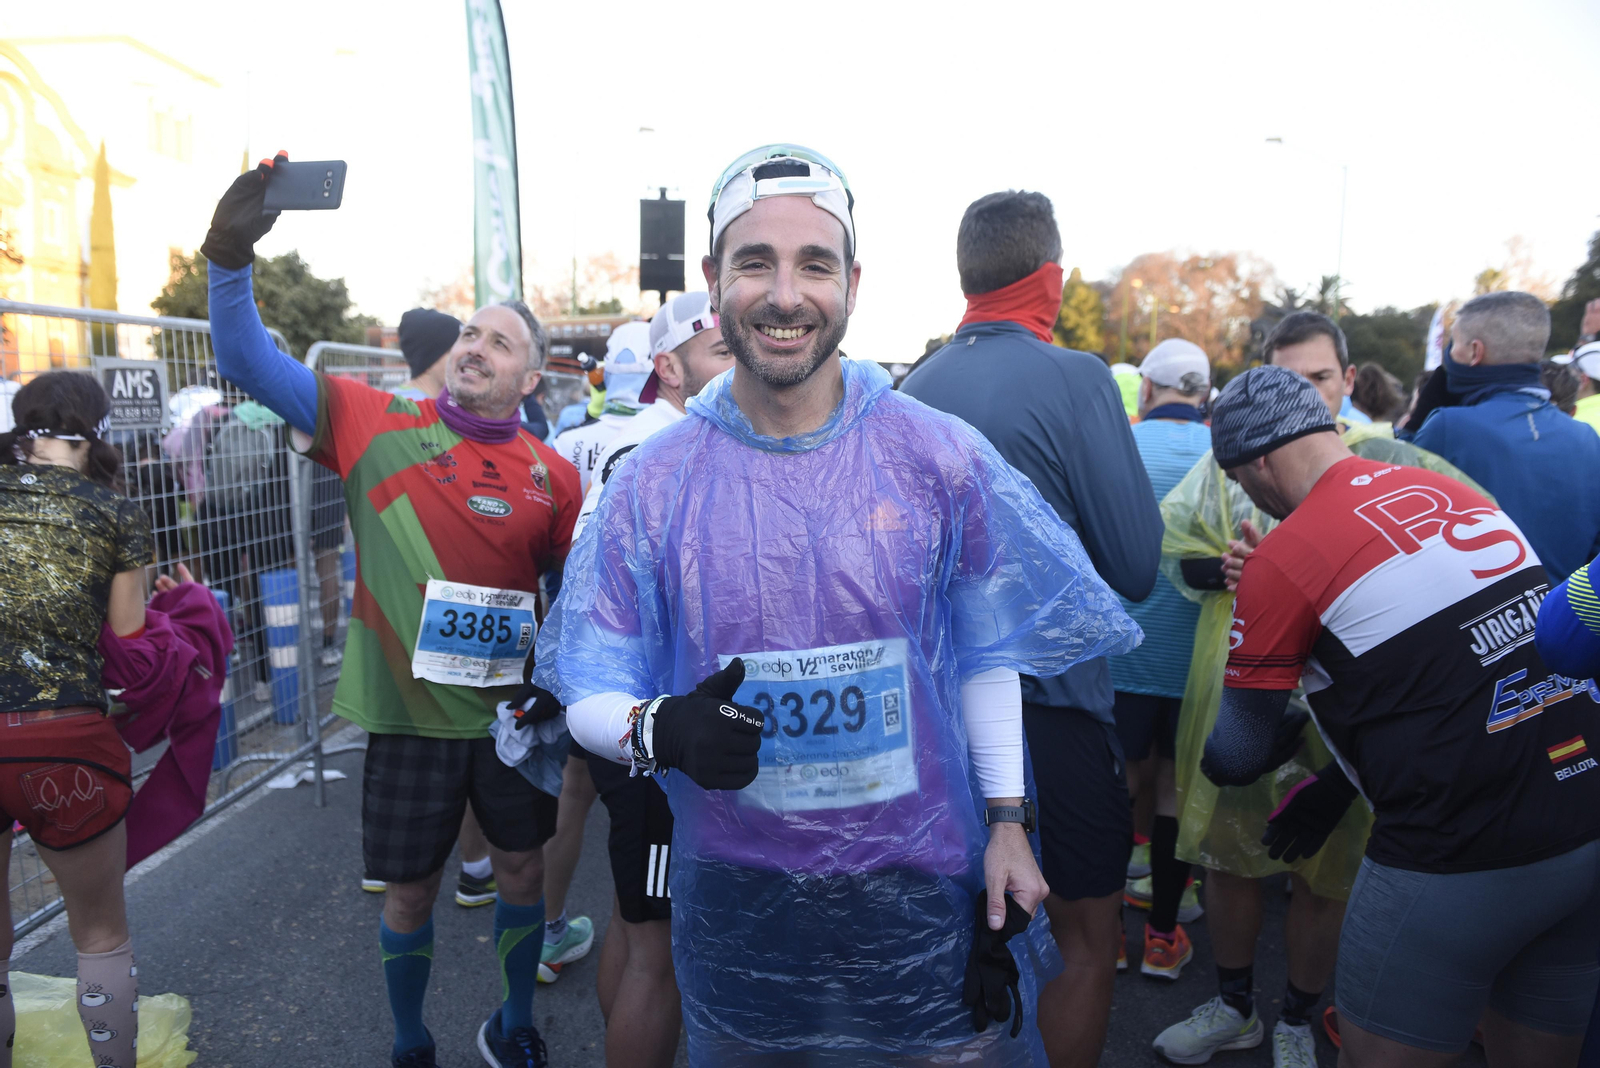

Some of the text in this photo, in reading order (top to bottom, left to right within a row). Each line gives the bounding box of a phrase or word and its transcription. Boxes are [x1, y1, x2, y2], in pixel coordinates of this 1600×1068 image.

[112, 370, 154, 398] AMS
[471, 497, 499, 507] LAND
[478, 504, 506, 514] ROVER
[439, 609, 512, 644] 3385
[761, 658, 793, 678] edp
[753, 685, 867, 739] 3329
[1554, 757, 1598, 781] BELLOTA
